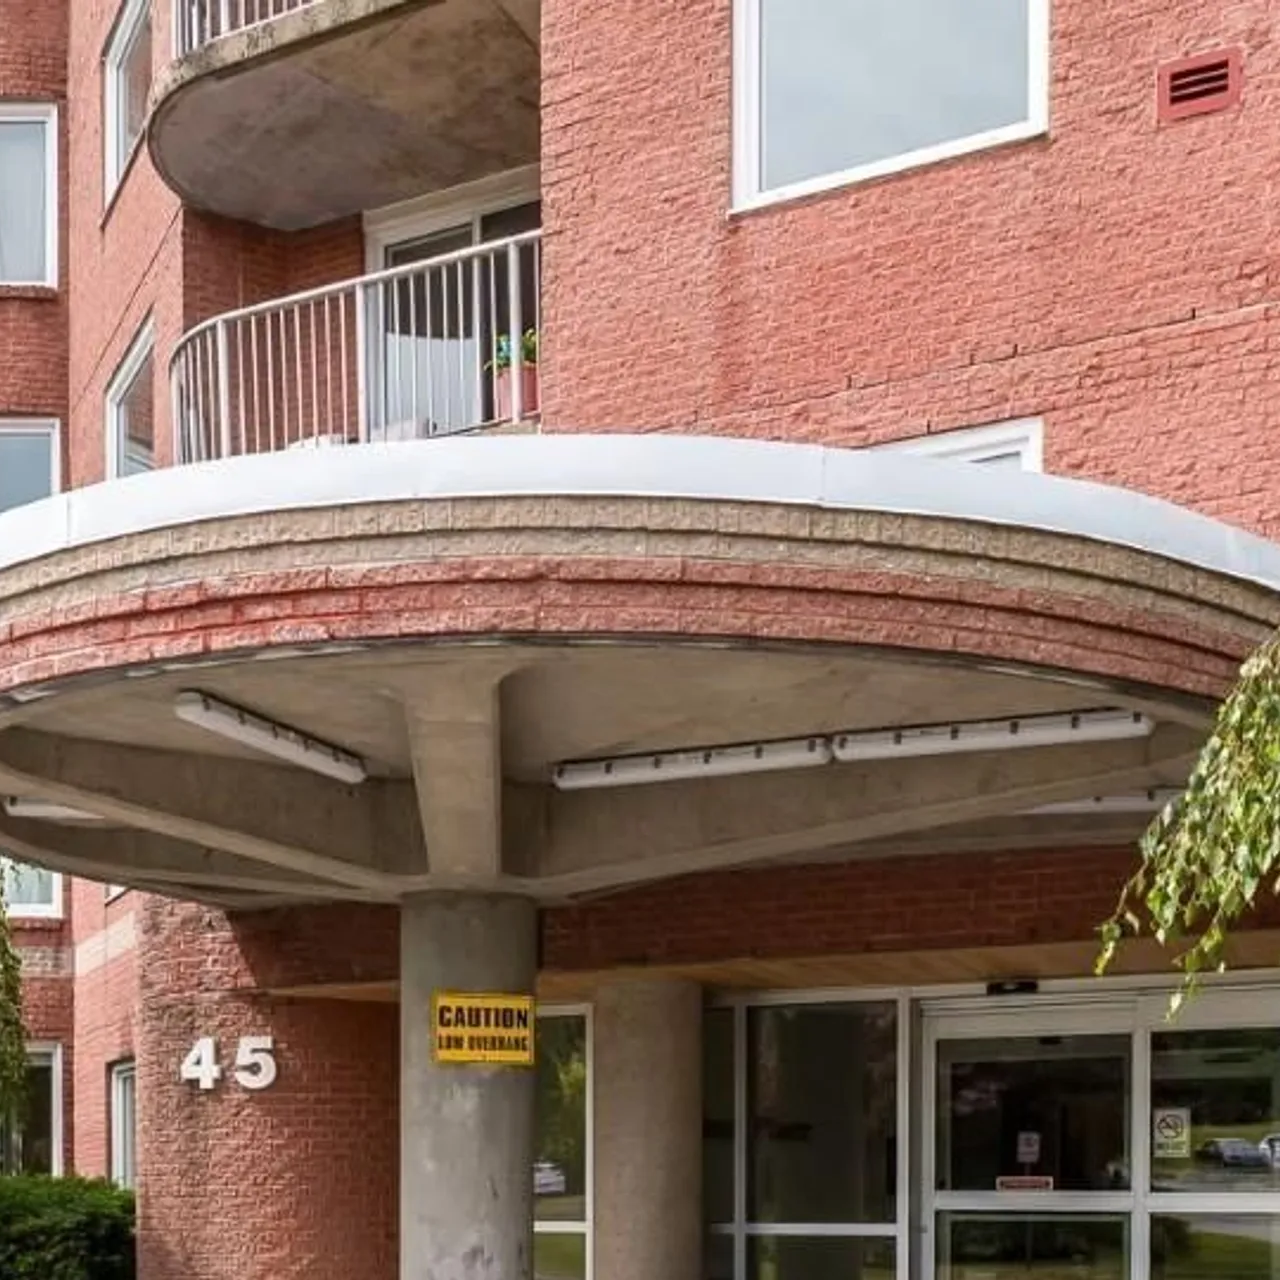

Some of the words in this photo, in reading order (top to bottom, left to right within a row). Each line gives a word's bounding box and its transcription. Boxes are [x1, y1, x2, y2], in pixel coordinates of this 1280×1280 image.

[438, 1005, 528, 1028] CAUTION
[438, 1035, 464, 1051] LOW
[180, 1036, 277, 1089] 45
